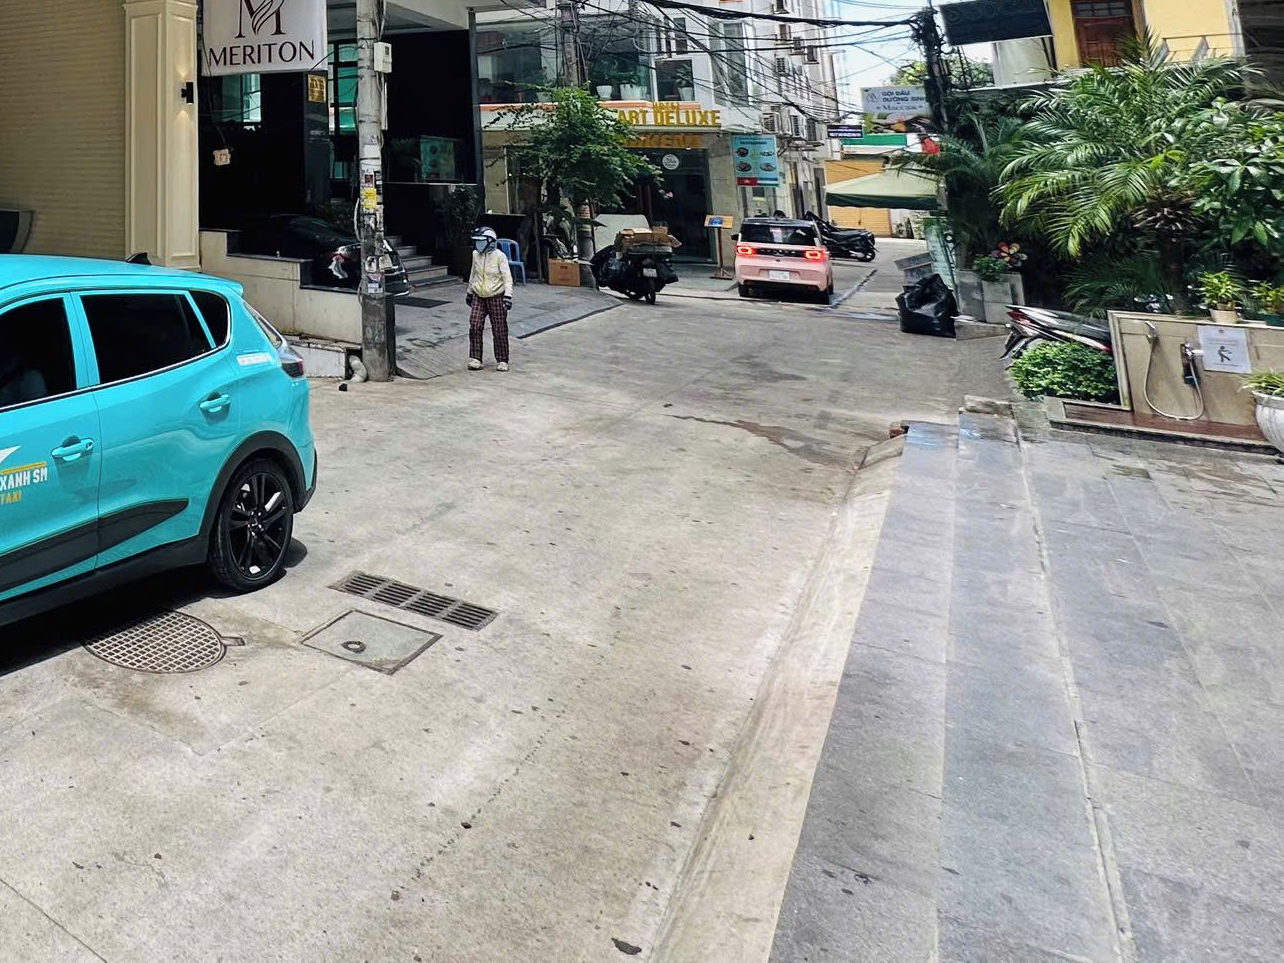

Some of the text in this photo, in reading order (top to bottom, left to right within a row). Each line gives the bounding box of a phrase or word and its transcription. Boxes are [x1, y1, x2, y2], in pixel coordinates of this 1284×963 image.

[209, 40, 315, 68] MERITON
[653, 109, 721, 126] DELUXE
[0, 470, 31, 492] XANH
[32, 467, 48, 484] SM
